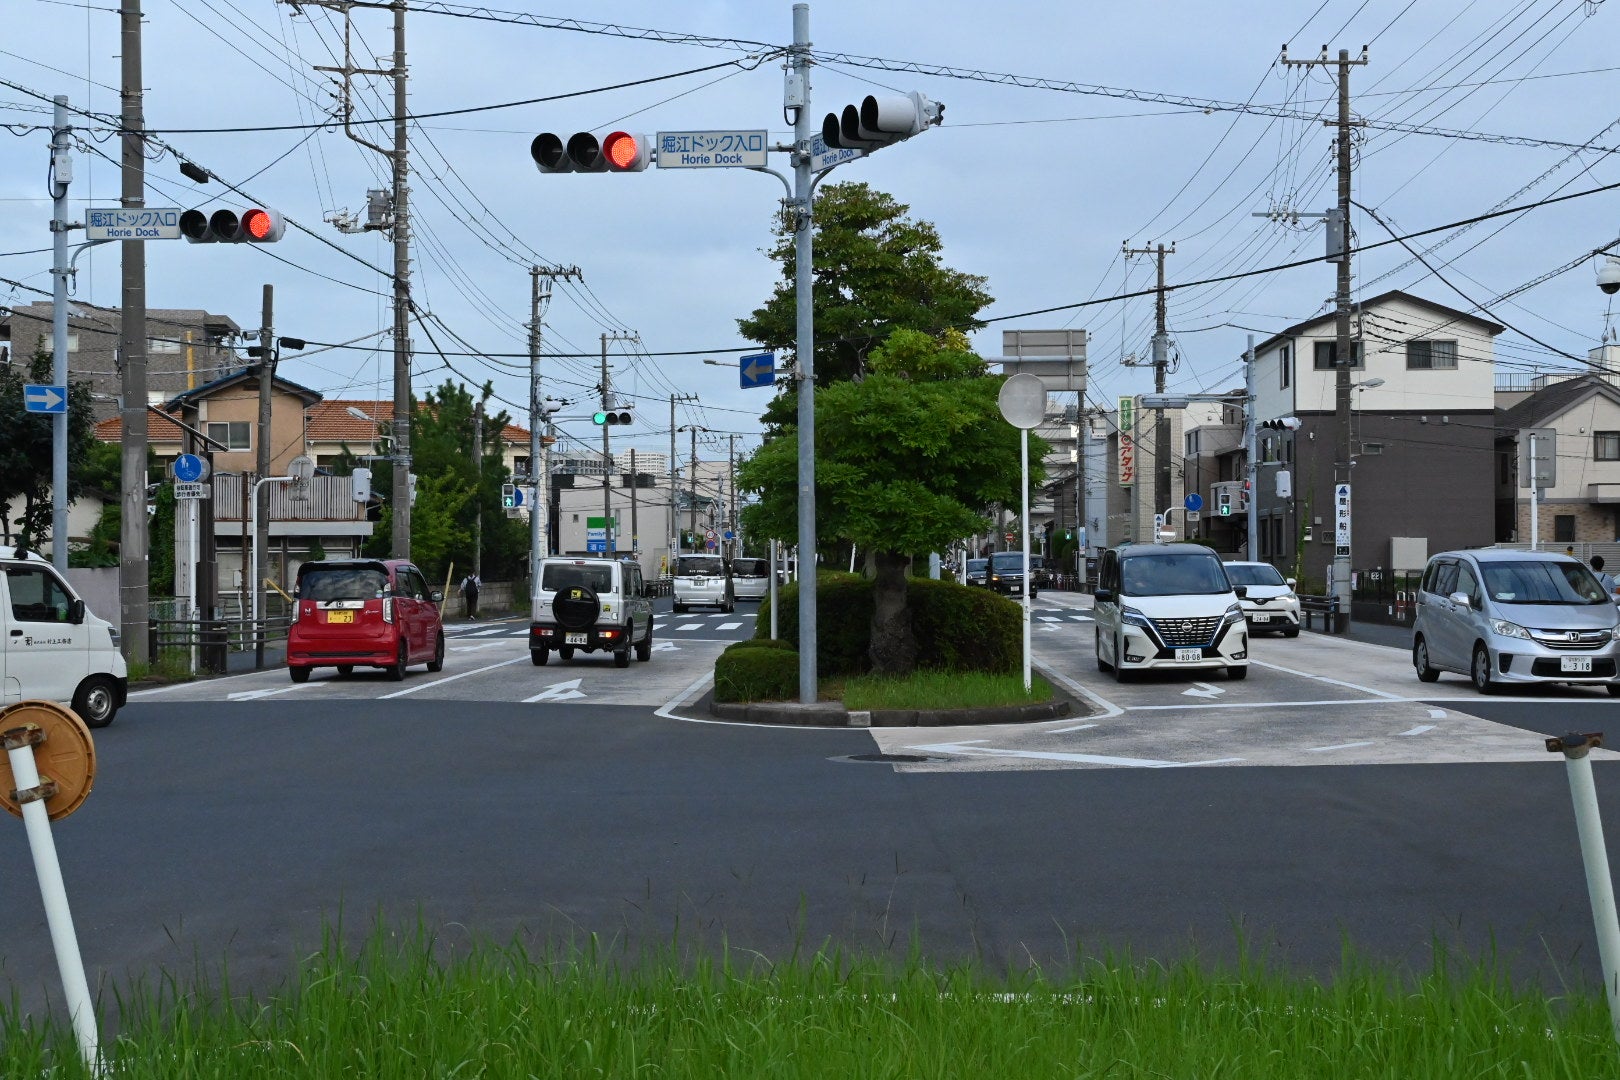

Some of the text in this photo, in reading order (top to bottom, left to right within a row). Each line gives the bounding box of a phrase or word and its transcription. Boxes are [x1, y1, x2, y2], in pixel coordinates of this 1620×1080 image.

[661, 135, 762, 153] 堀江ドック入口
[681, 153, 743, 164] Horie Dock
[822, 148, 854, 166] Horie Dock
[91, 212, 177, 227] 堀江ドック入口
[107, 228, 160, 237] Horie Dock
[1120, 446, 1133, 482] アタック
[1181, 653, 1200, 661] 80-08
